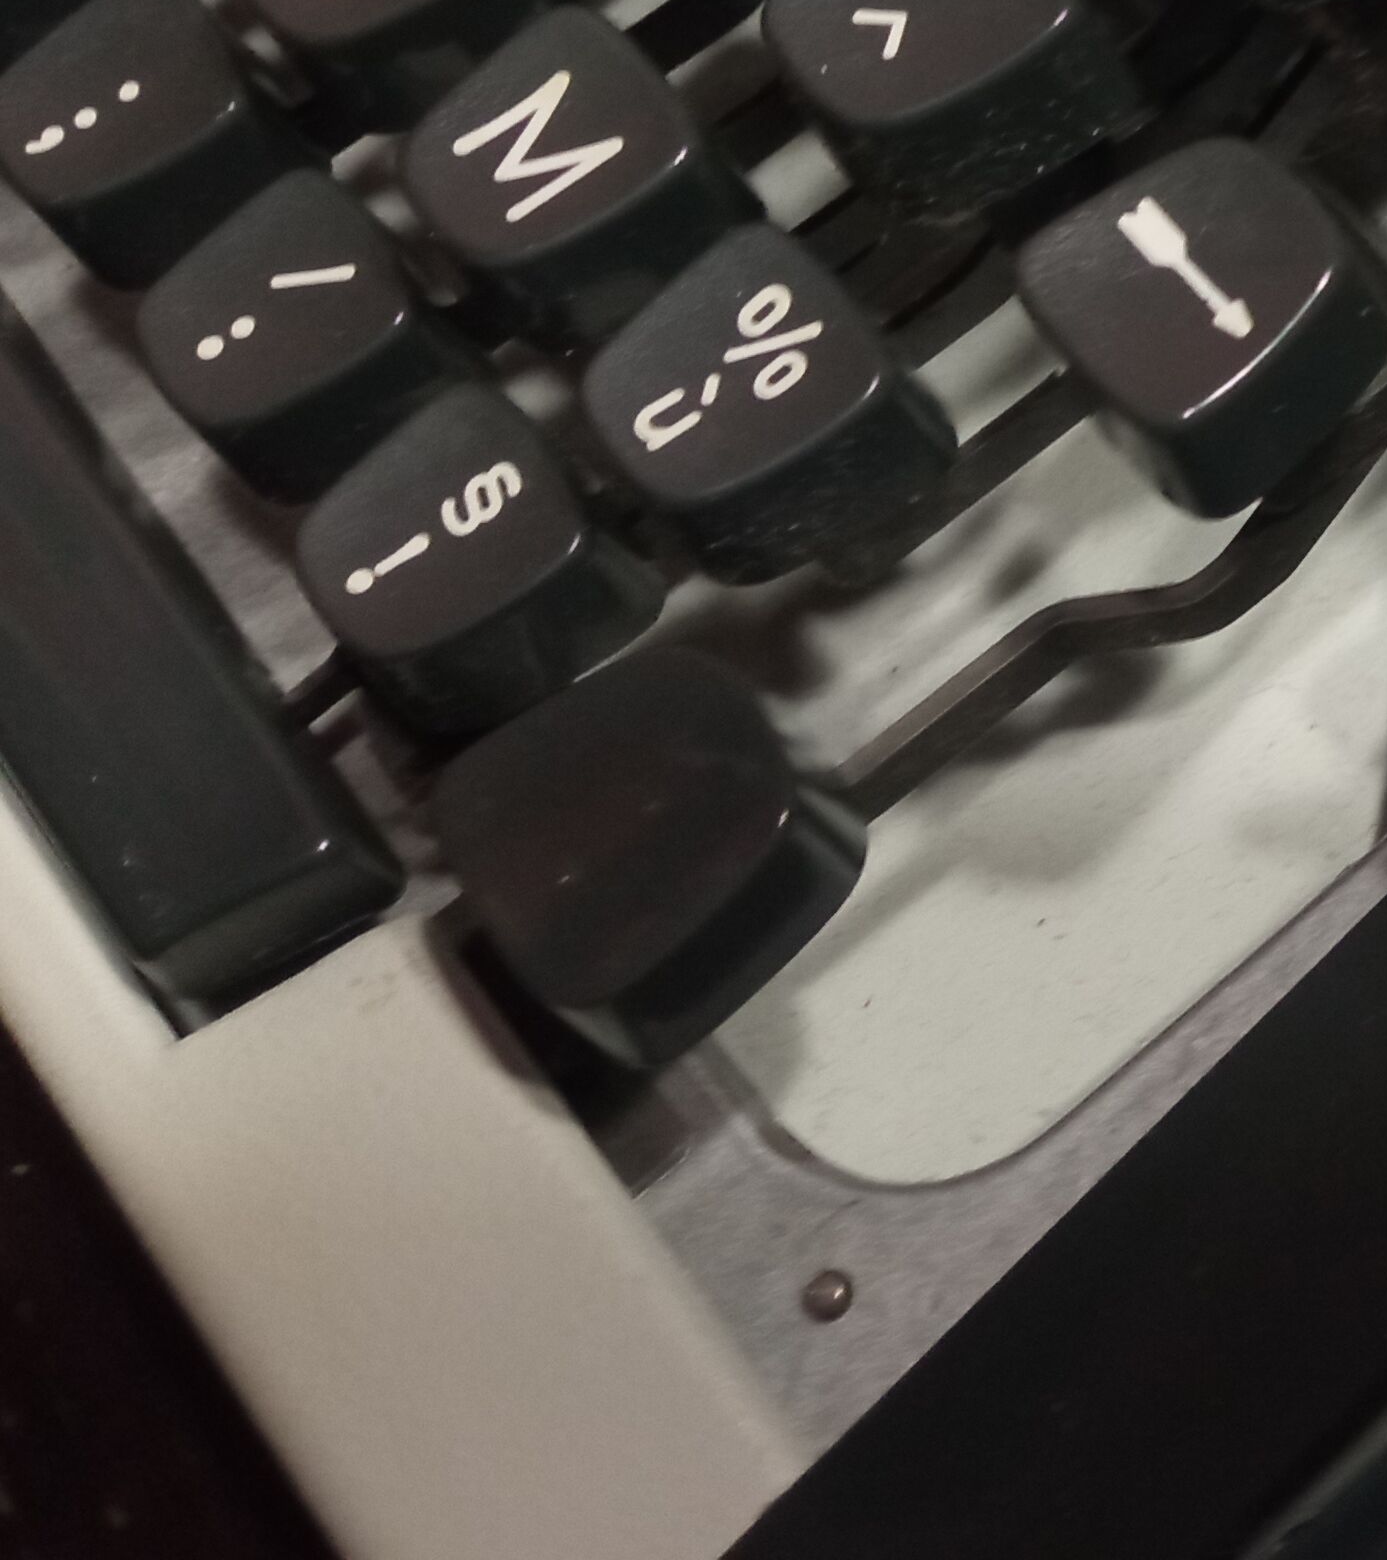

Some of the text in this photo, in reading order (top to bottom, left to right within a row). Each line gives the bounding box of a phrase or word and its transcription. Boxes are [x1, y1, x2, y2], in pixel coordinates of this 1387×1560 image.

[452, 70, 624, 223] M
[723, 284, 823, 400] %
[440, 461, 522, 537] §
[345, 533, 430, 595] !
